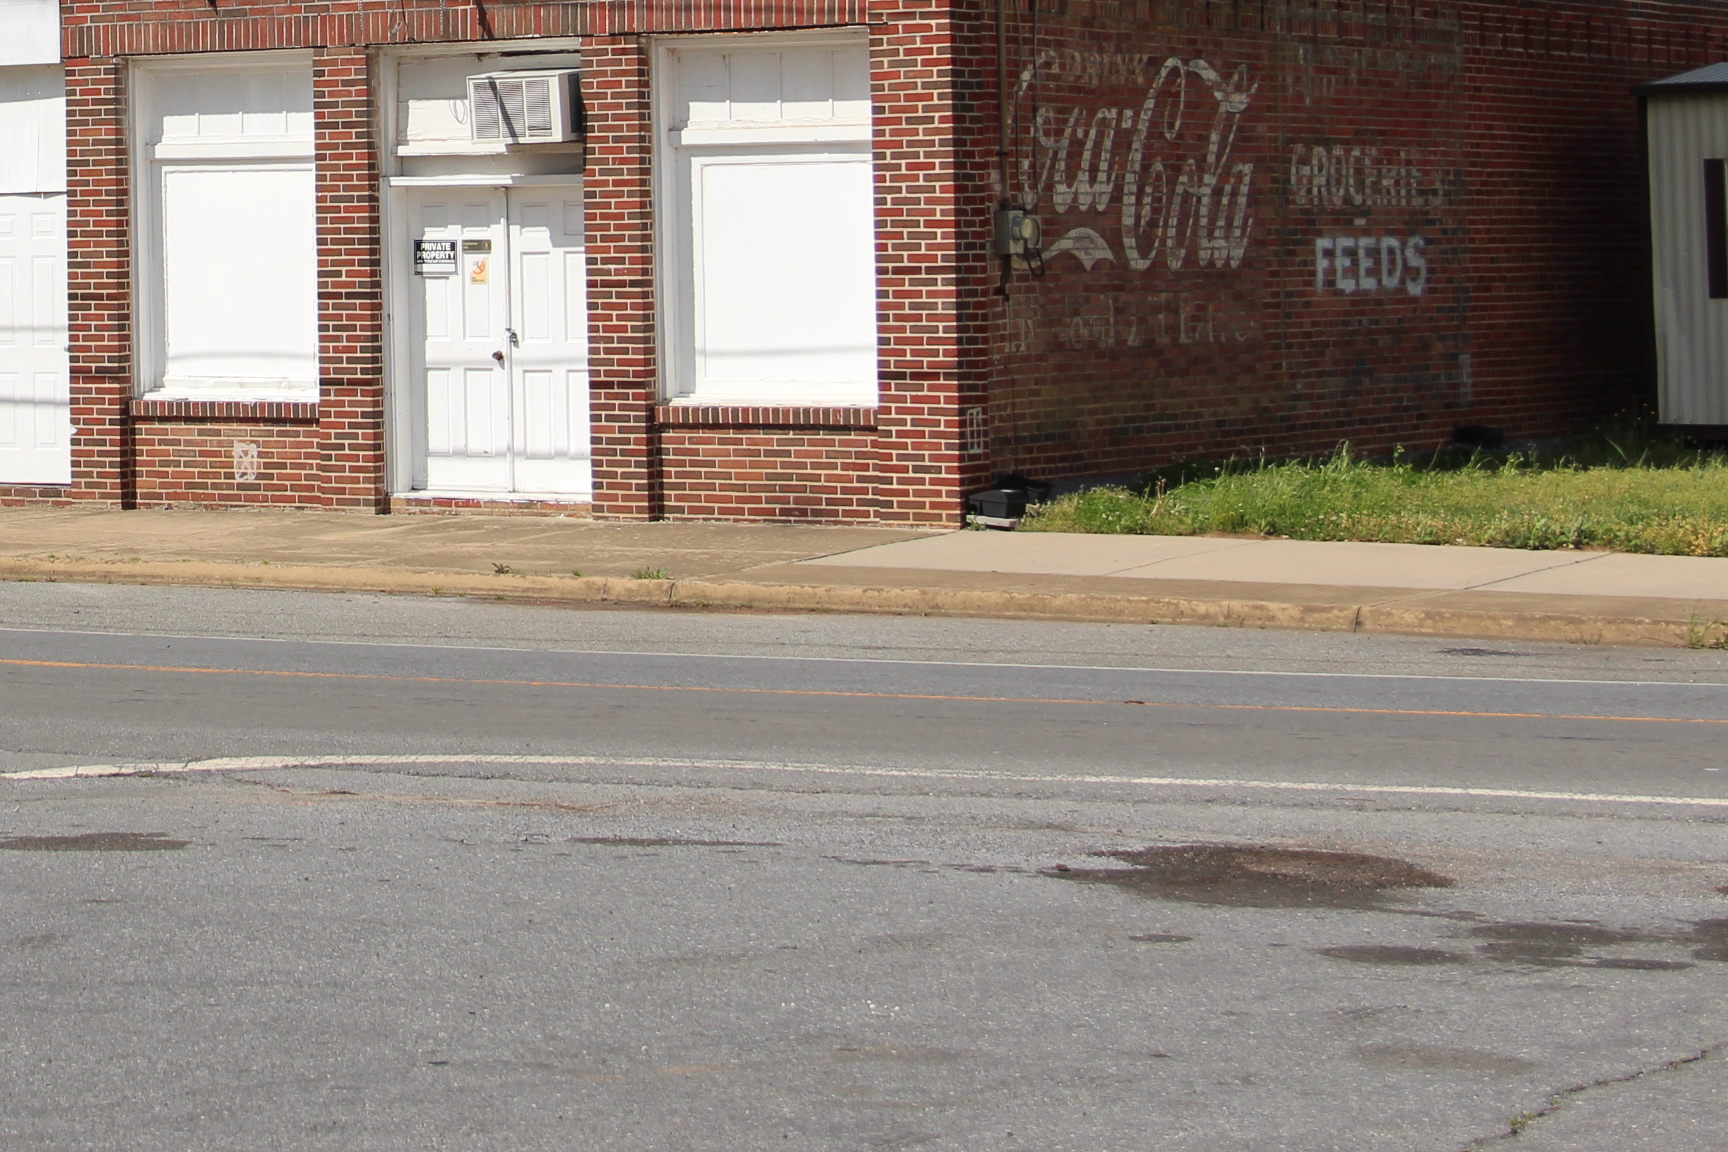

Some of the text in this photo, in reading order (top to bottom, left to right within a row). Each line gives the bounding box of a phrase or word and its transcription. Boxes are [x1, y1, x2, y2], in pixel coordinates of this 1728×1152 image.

[420, 242, 452, 250] PRIVATE
[416, 250, 455, 259] PROPERTY
[1315, 236, 1426, 296] FEEDS
